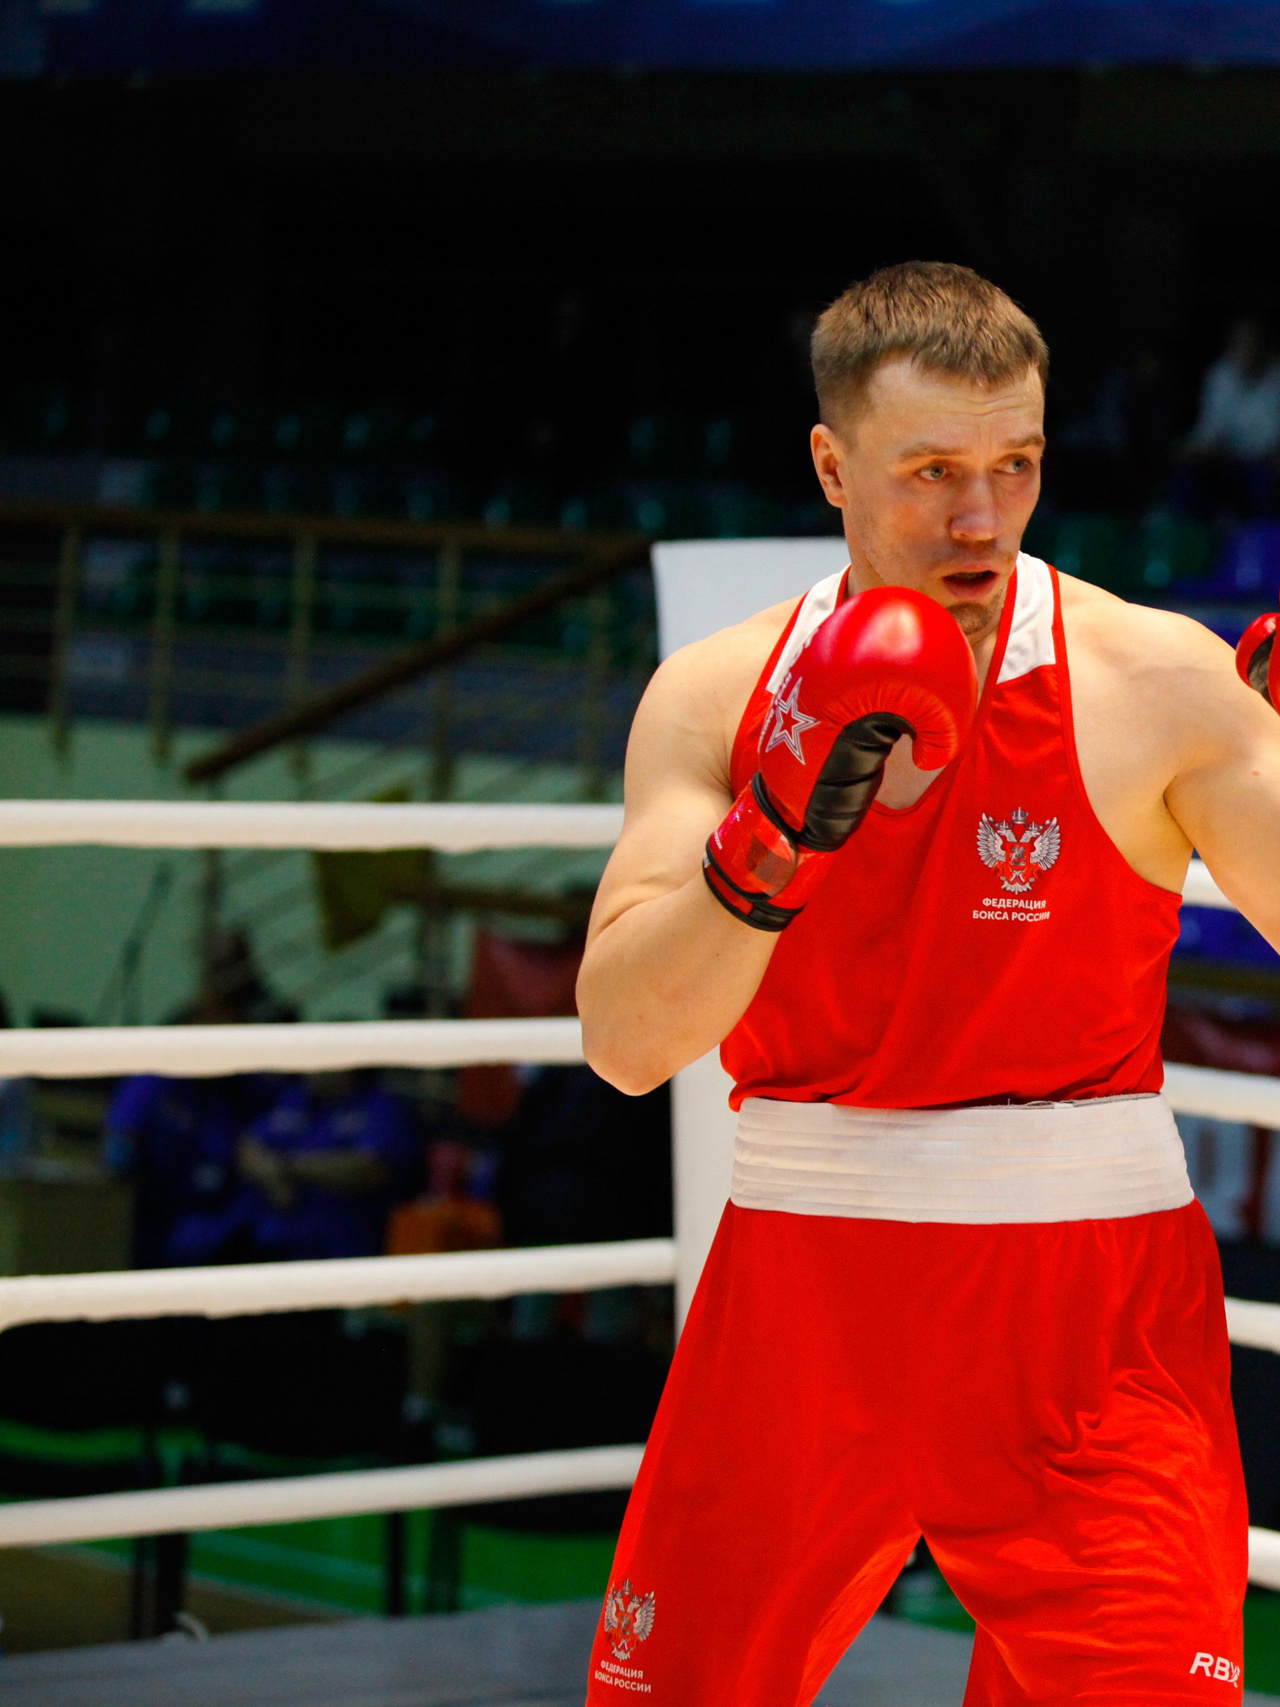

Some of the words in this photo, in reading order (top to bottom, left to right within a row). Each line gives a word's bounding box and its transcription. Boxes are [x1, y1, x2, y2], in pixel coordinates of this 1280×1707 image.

[982, 897, 1047, 910] ФЕДЕРАЦИЯ
[972, 909, 1009, 920] БОКСА
[1011, 911, 1051, 922] РОССИИ
[601, 1660, 643, 1679] ФЕДЕРАЦИЯ
[595, 1670, 613, 1685] БОКСА
[614, 1678, 651, 1692] РОССИИ
